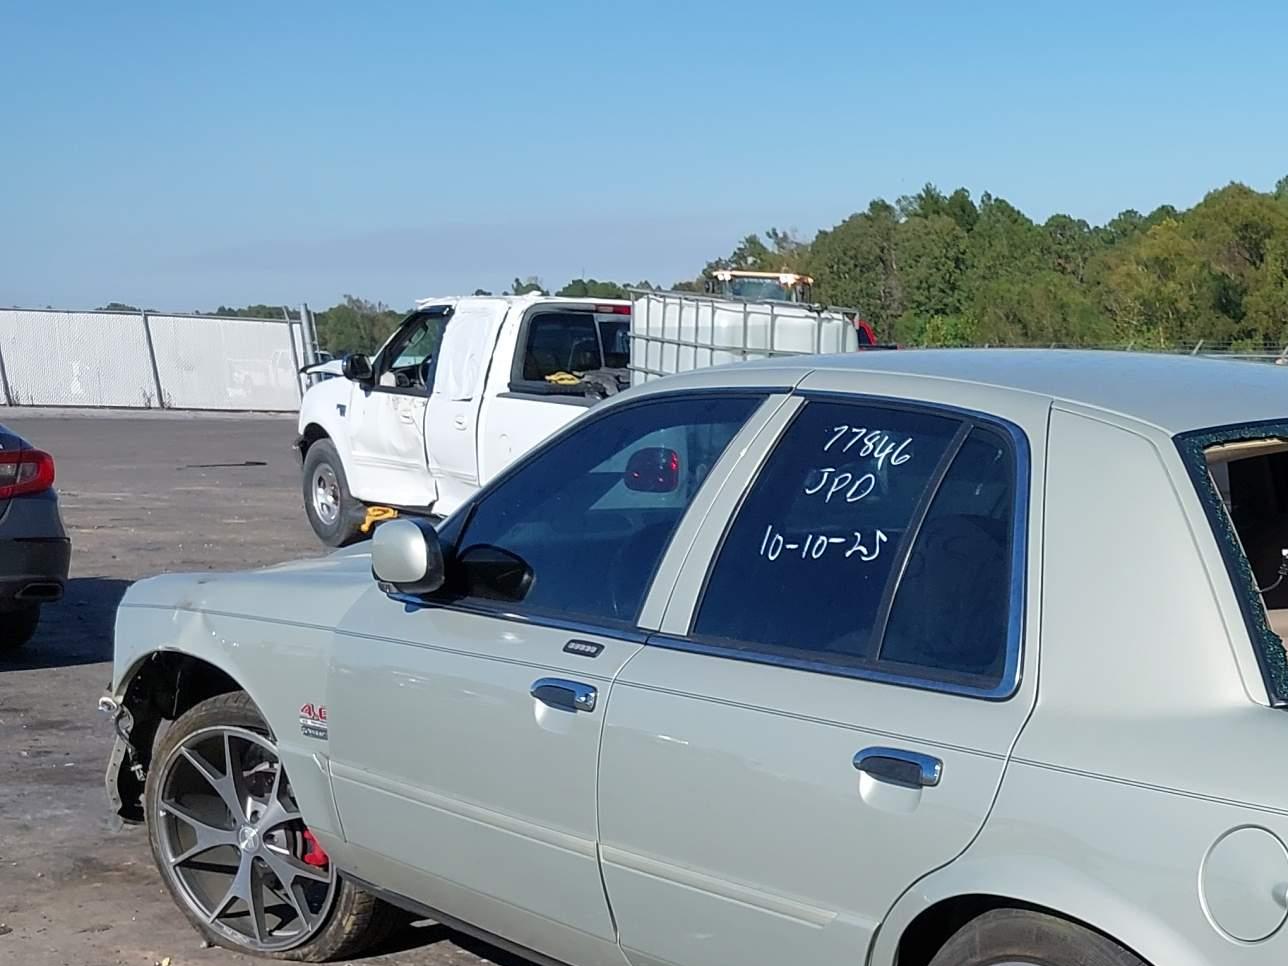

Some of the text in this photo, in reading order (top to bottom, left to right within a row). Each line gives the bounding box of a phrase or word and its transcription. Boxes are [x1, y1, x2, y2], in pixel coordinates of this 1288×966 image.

[824, 424, 913, 471] 77846
[804, 467, 876, 503] JPD
[759, 524, 889, 562] 10-10-25
